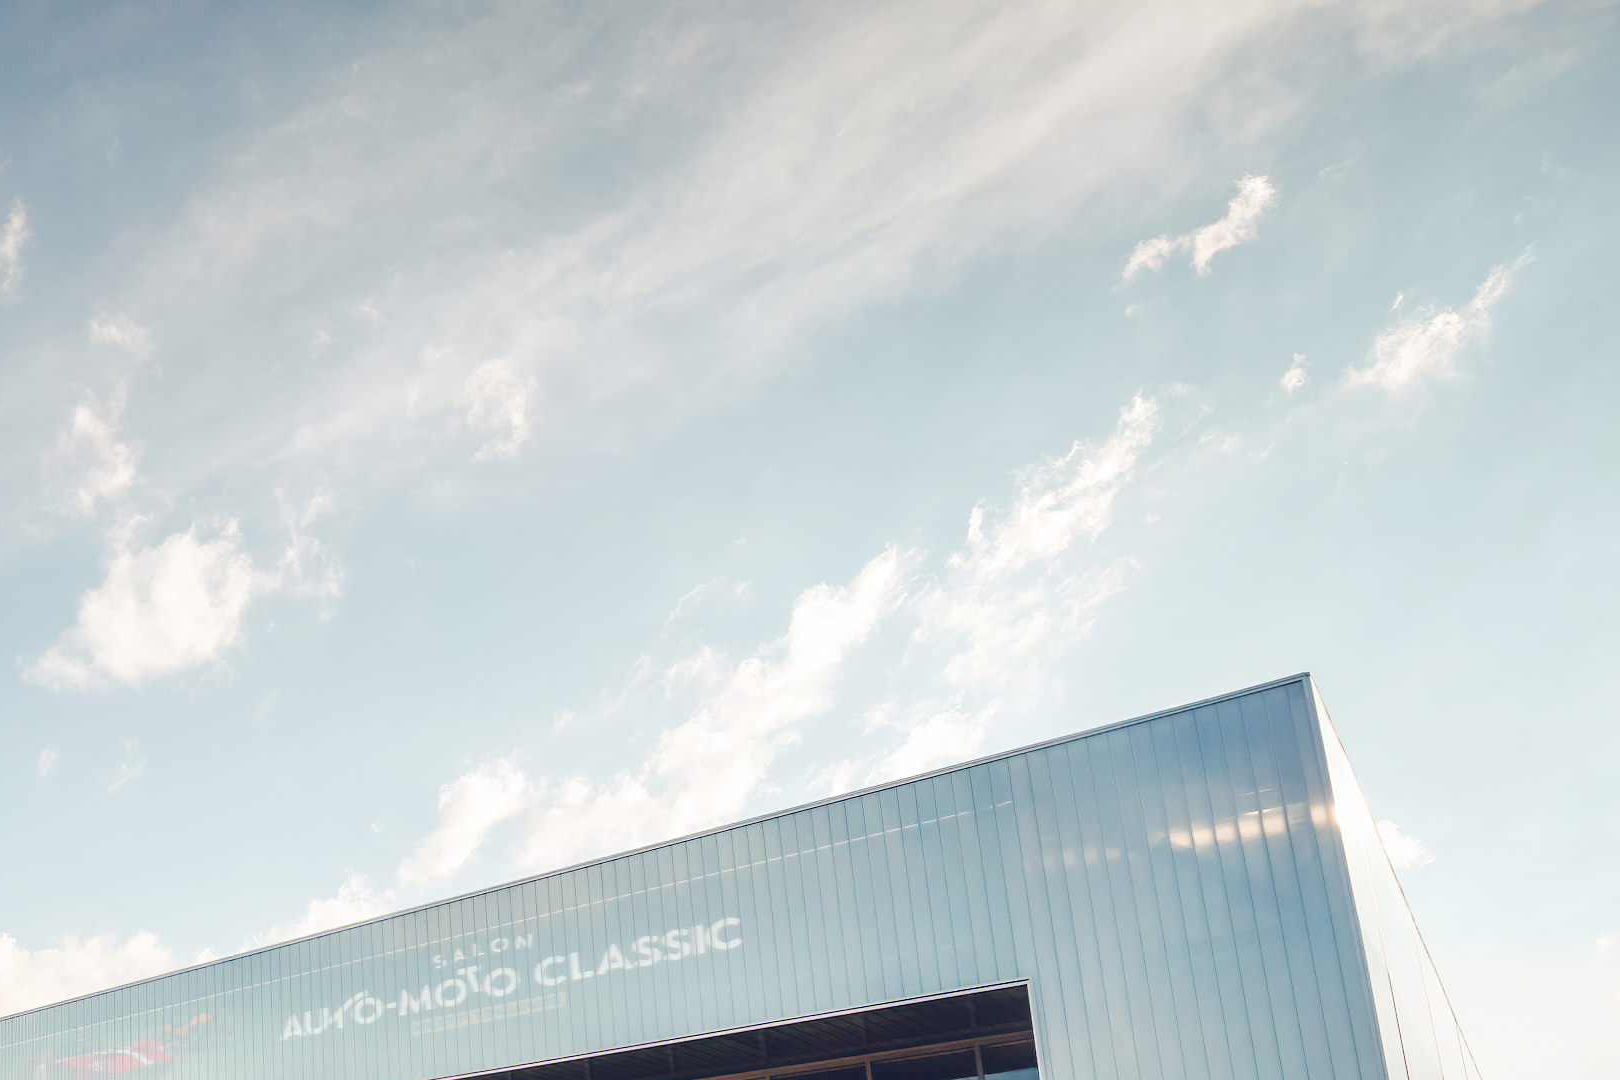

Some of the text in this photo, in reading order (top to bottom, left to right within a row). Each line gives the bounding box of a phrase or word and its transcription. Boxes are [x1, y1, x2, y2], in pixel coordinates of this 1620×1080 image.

[279, 963, 519, 1041] AUTO-MOTO
[533, 917, 742, 986] CLASSIC
[433, 933, 534, 970] SALON
